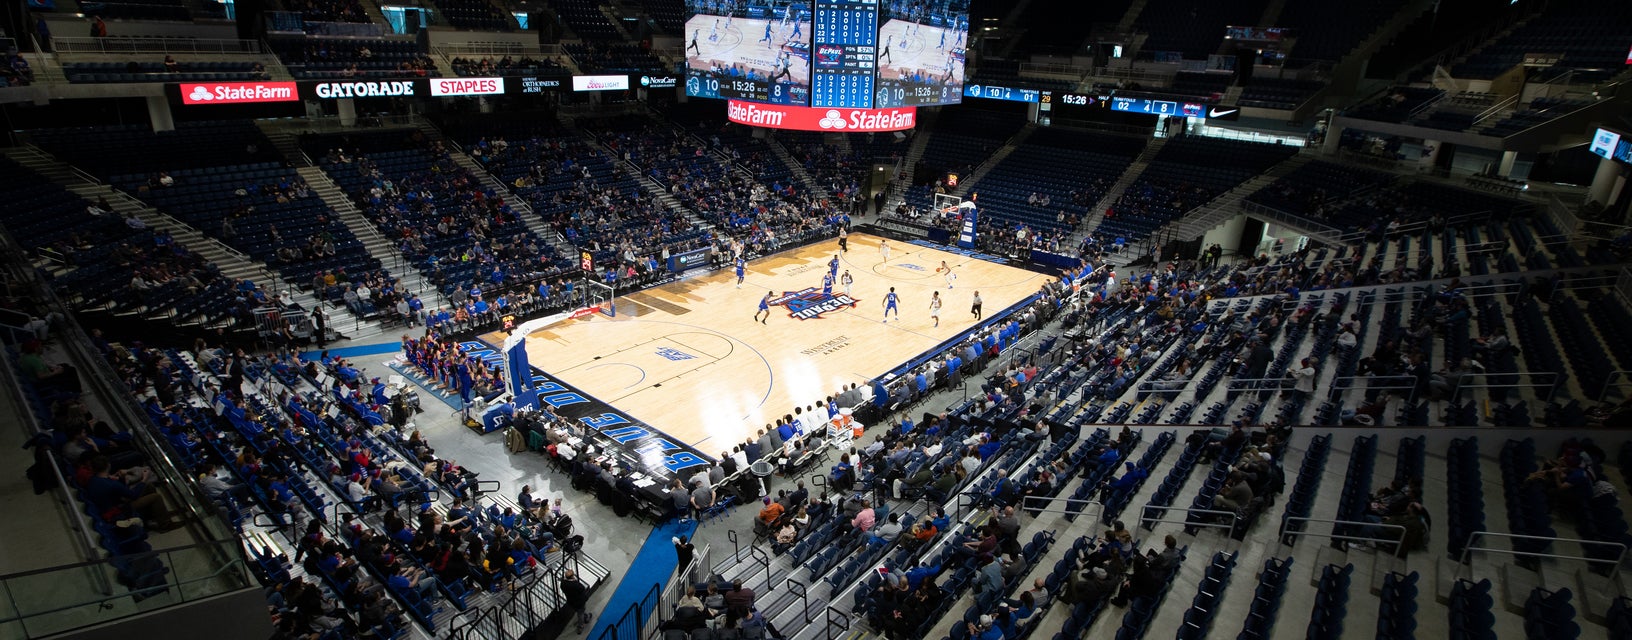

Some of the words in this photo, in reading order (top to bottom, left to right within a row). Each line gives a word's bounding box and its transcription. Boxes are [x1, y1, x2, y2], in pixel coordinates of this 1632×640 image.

[440, 80, 497, 94] STAPLES
[706, 80, 718, 88] 10
[732, 80, 755, 92] 15:26
[315, 81, 414, 98] GATORADE
[774, 85, 781, 96] 8
[894, 88, 904, 100] 10
[915, 87, 931, 96] 15:26
[942, 87, 948, 97] 8
[990, 88, 999, 96] 10
[1062, 94, 1086, 105] 15:26
[1118, 102, 1129, 110] 02
[1161, 104, 1167, 112] 8
